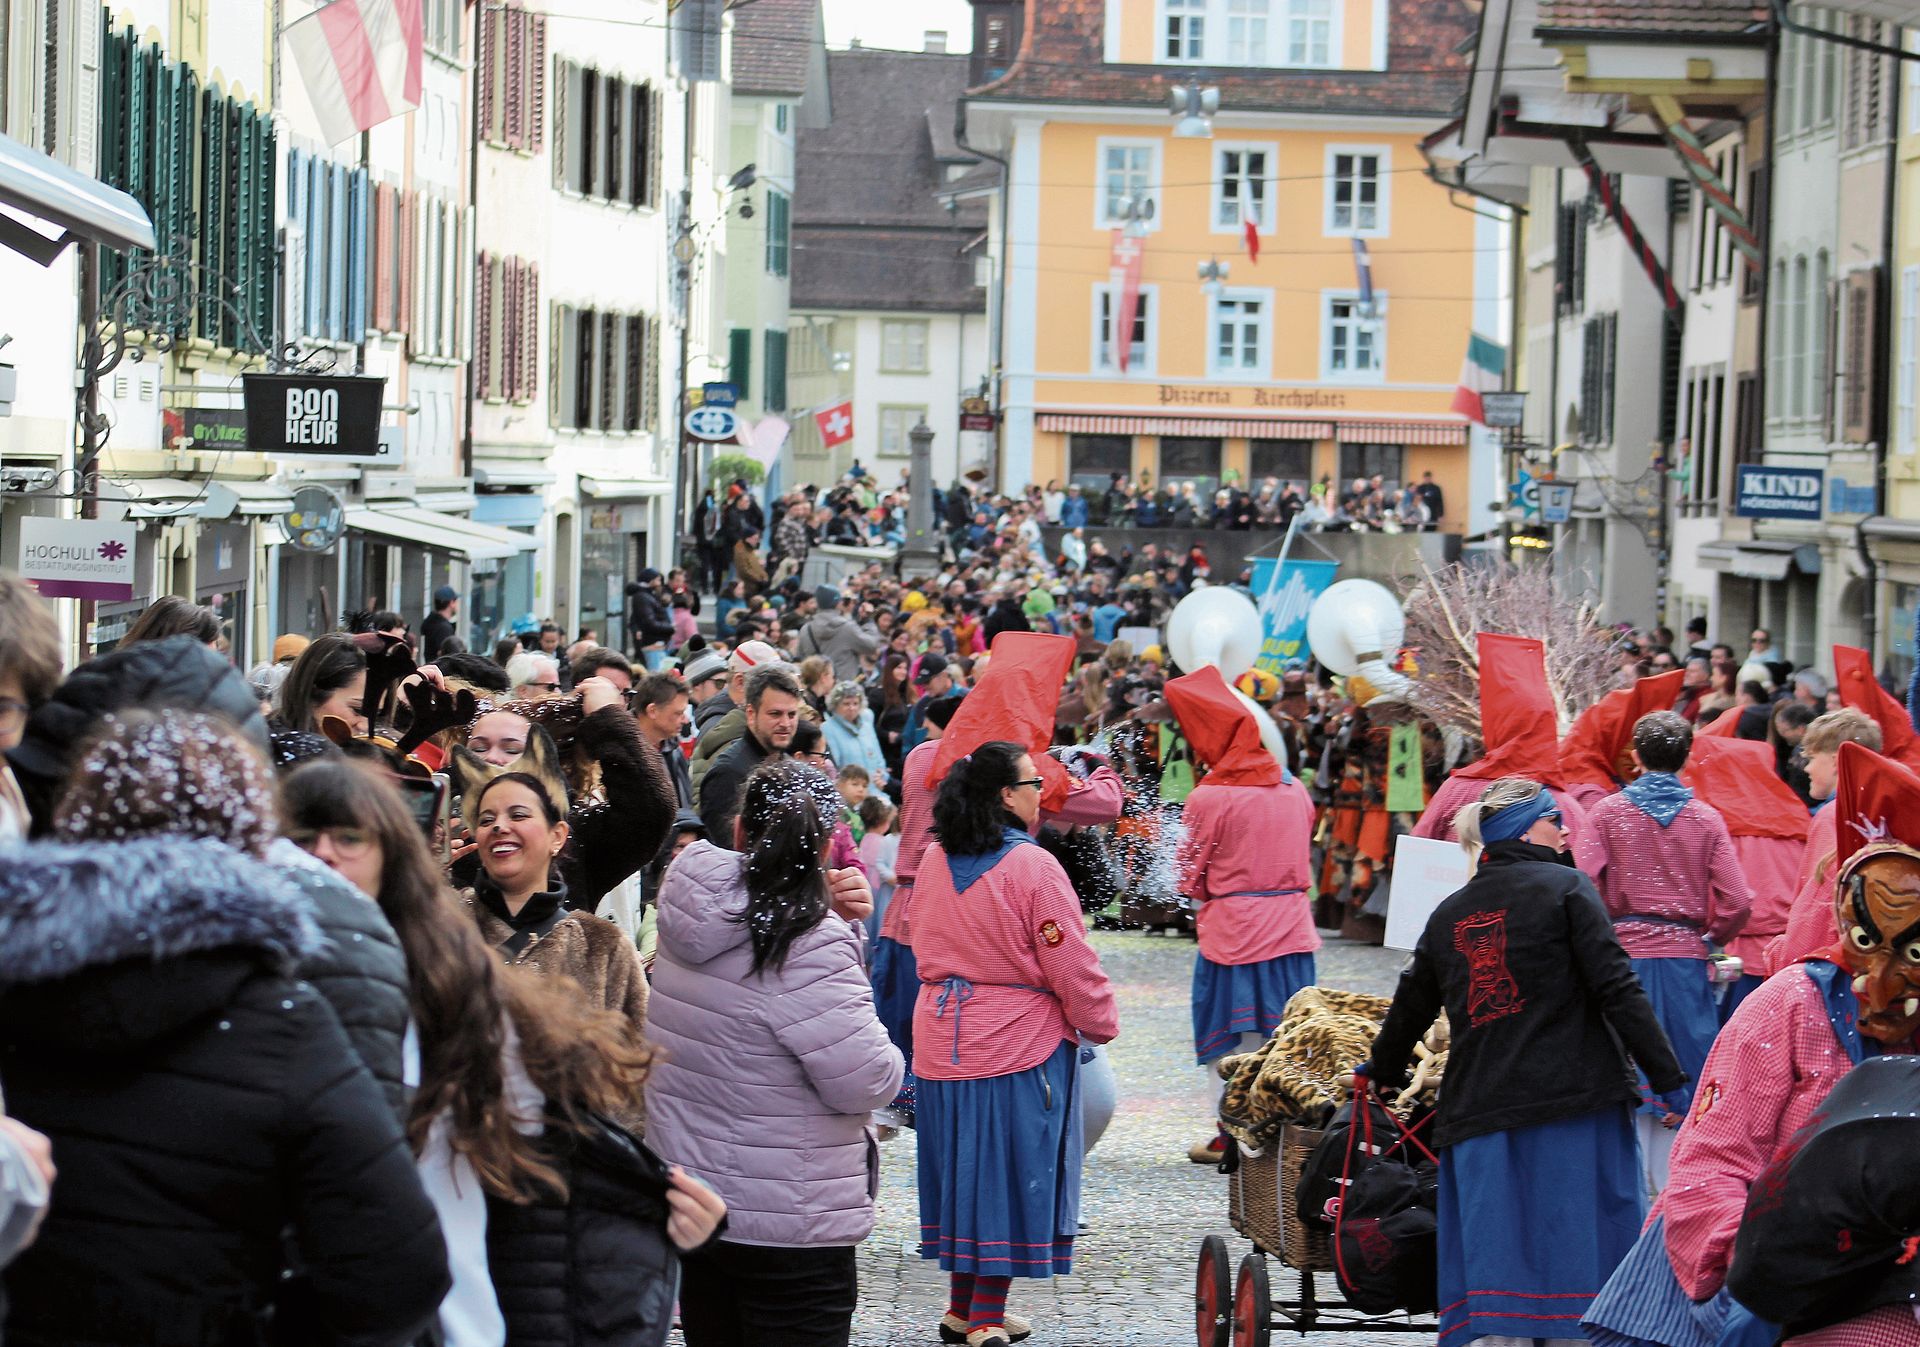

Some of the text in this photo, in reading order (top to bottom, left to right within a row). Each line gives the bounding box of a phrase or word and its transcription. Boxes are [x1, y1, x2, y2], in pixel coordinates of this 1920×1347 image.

[286, 387, 339, 421] BON
[1159, 385, 1346, 409] Pizzeria Kirchplatz
[286, 420, 338, 445] HEUR
[1742, 473, 1819, 497] KIND
[25, 544, 96, 561] HOCHULI
[25, 560, 127, 574] BESTATTUNGSINSTITUT
